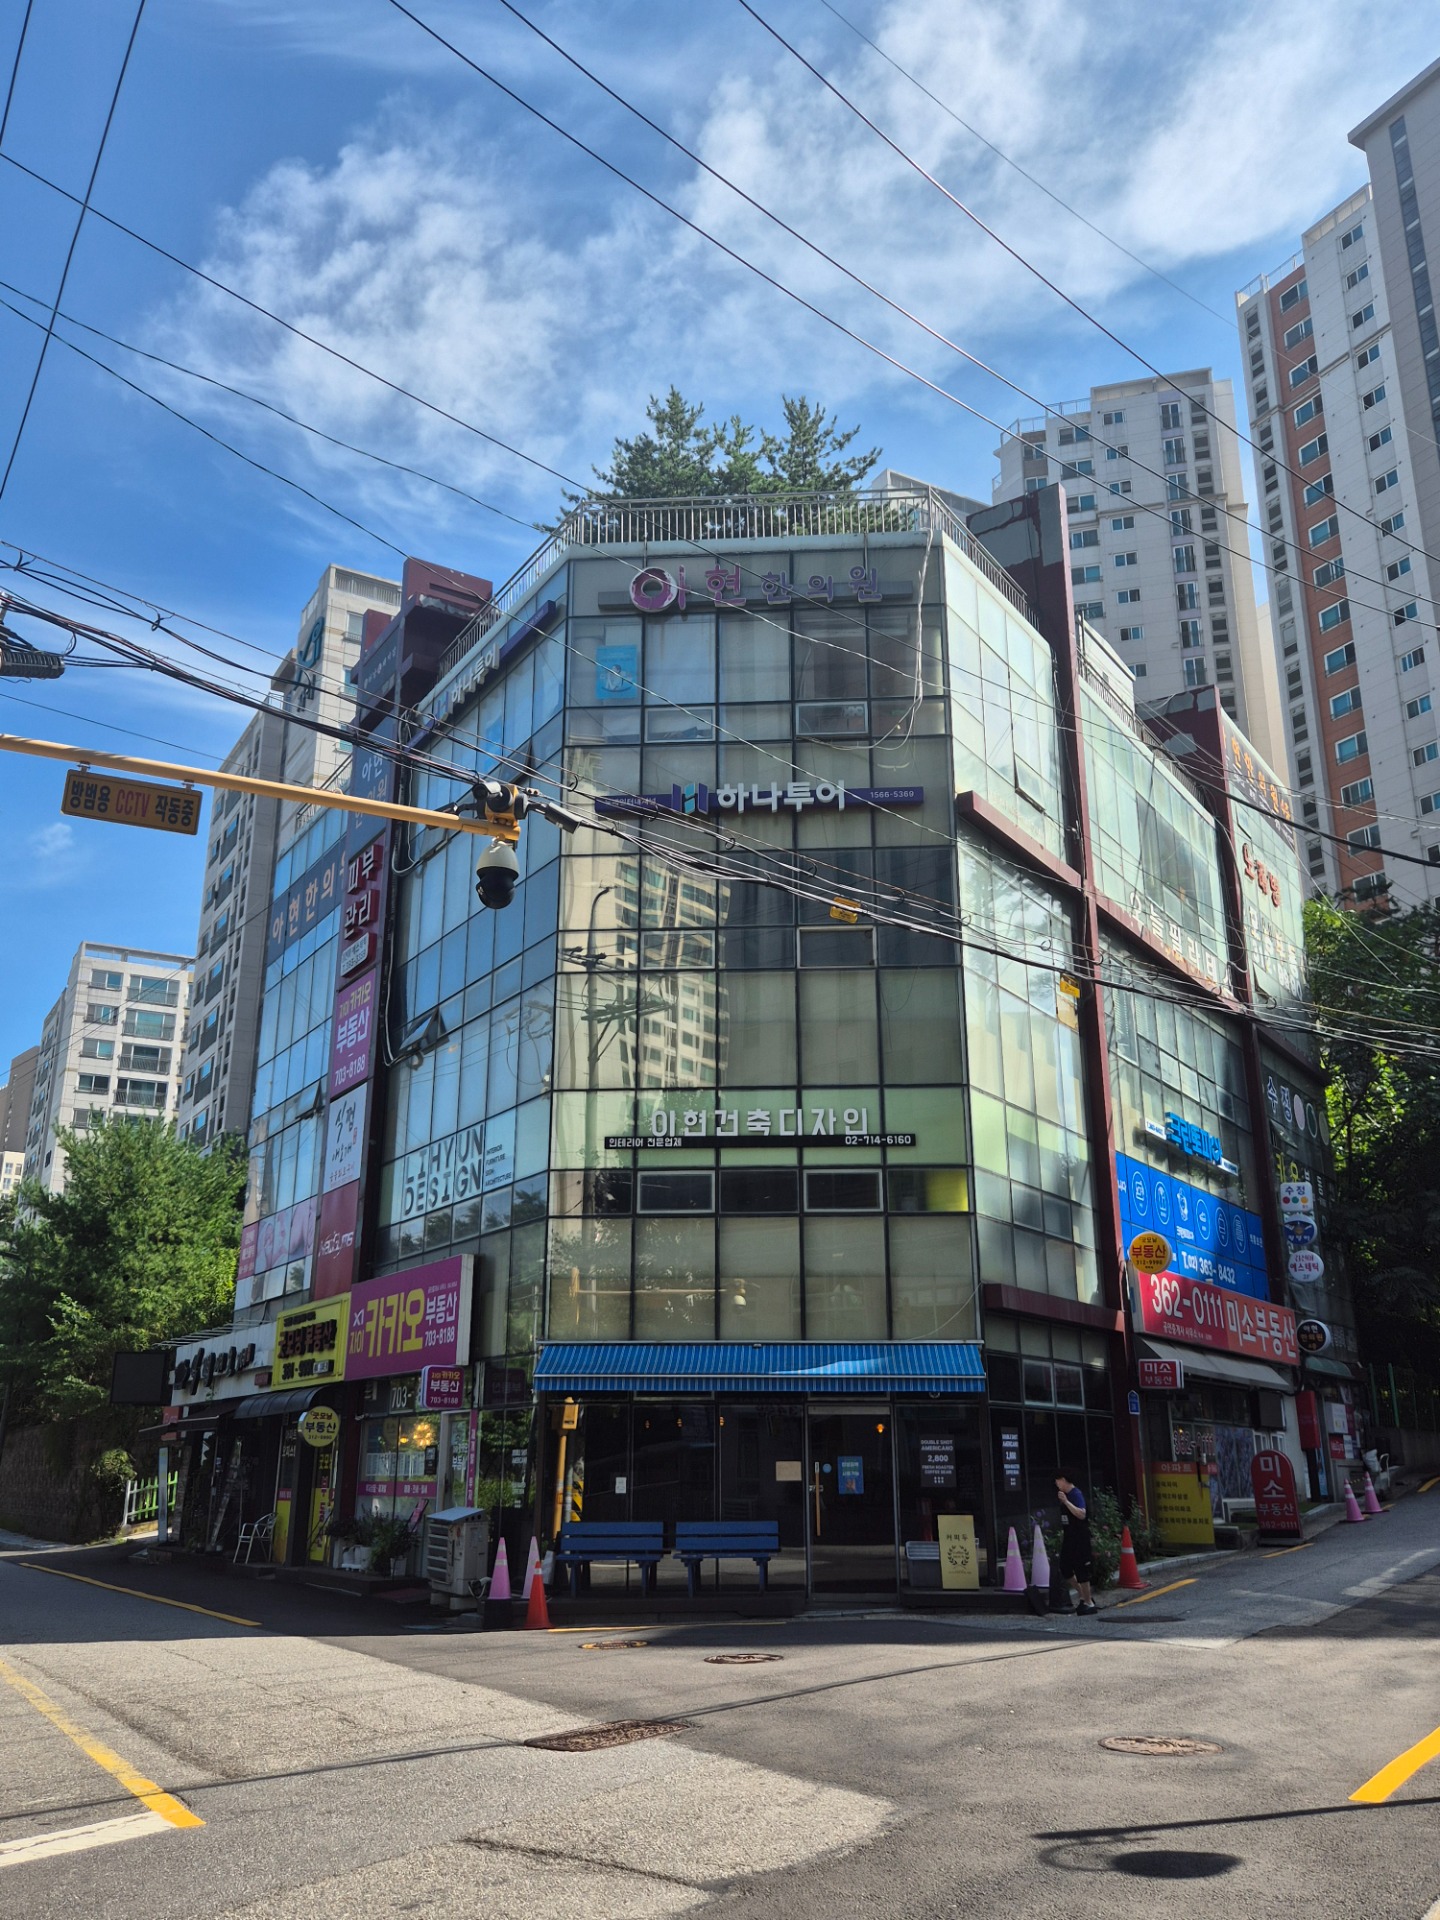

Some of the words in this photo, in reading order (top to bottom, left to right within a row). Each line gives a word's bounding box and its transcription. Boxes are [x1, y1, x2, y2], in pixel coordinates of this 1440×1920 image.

[629, 562, 883, 613] 아현한의원
[451, 644, 499, 705] 하나투어
[69, 780, 111, 814] 방범용
[115, 788, 150, 818] CCTV
[155, 794, 195, 828] 작동중
[716, 779, 845, 813] 하나투어
[344, 889, 372, 940] 관리
[350, 981, 372, 1012] 카카오
[336, 1006, 370, 1053] 부동산
[334, 1053, 366, 1087] 703-8188
[651, 1107, 868, 1137] 이현건축디자인
[608, 1137, 644, 1148] 인테리어
[647, 1137, 682, 1148] 전문업체
[844, 1134, 912, 1145] 02-714-6160
[405, 1124, 485, 1185] LIHYUN
[404, 1158, 482, 1217] DESIGN
[485, 1171, 512, 1186] ARCHITECTURE
[1285, 1185, 1306, 1196] 수정
[1131, 1245, 1167, 1259] 부동산
[1217, 1263, 1236, 1285] 8432
[1289, 1262, 1319, 1273] 에스테틱
[365, 1288, 425, 1358] 카카오
[425, 1291, 458, 1326] 부동산
[1150, 1273, 1225, 1329] 362-0111
[1226, 1299, 1297, 1358] 미소부동산
[424, 1326, 456, 1347] 703-8188
[441, 1370, 461, 1381] 카카오
[1143, 1362, 1173, 1374] 미소
[430, 1380, 460, 1393] 부동산
[1144, 1375, 1173, 1386] 부동산
[430, 1396, 459, 1405] 703-8188
[305, 1420, 336, 1433] 부동산
[927, 1454, 949, 1463] 2,800
[1160, 1463, 1193, 1473] 아파트
[1260, 1455, 1287, 1498] 미소
[1259, 1503, 1294, 1516] 부동산
[1260, 1520, 1298, 1529] 362-0111
